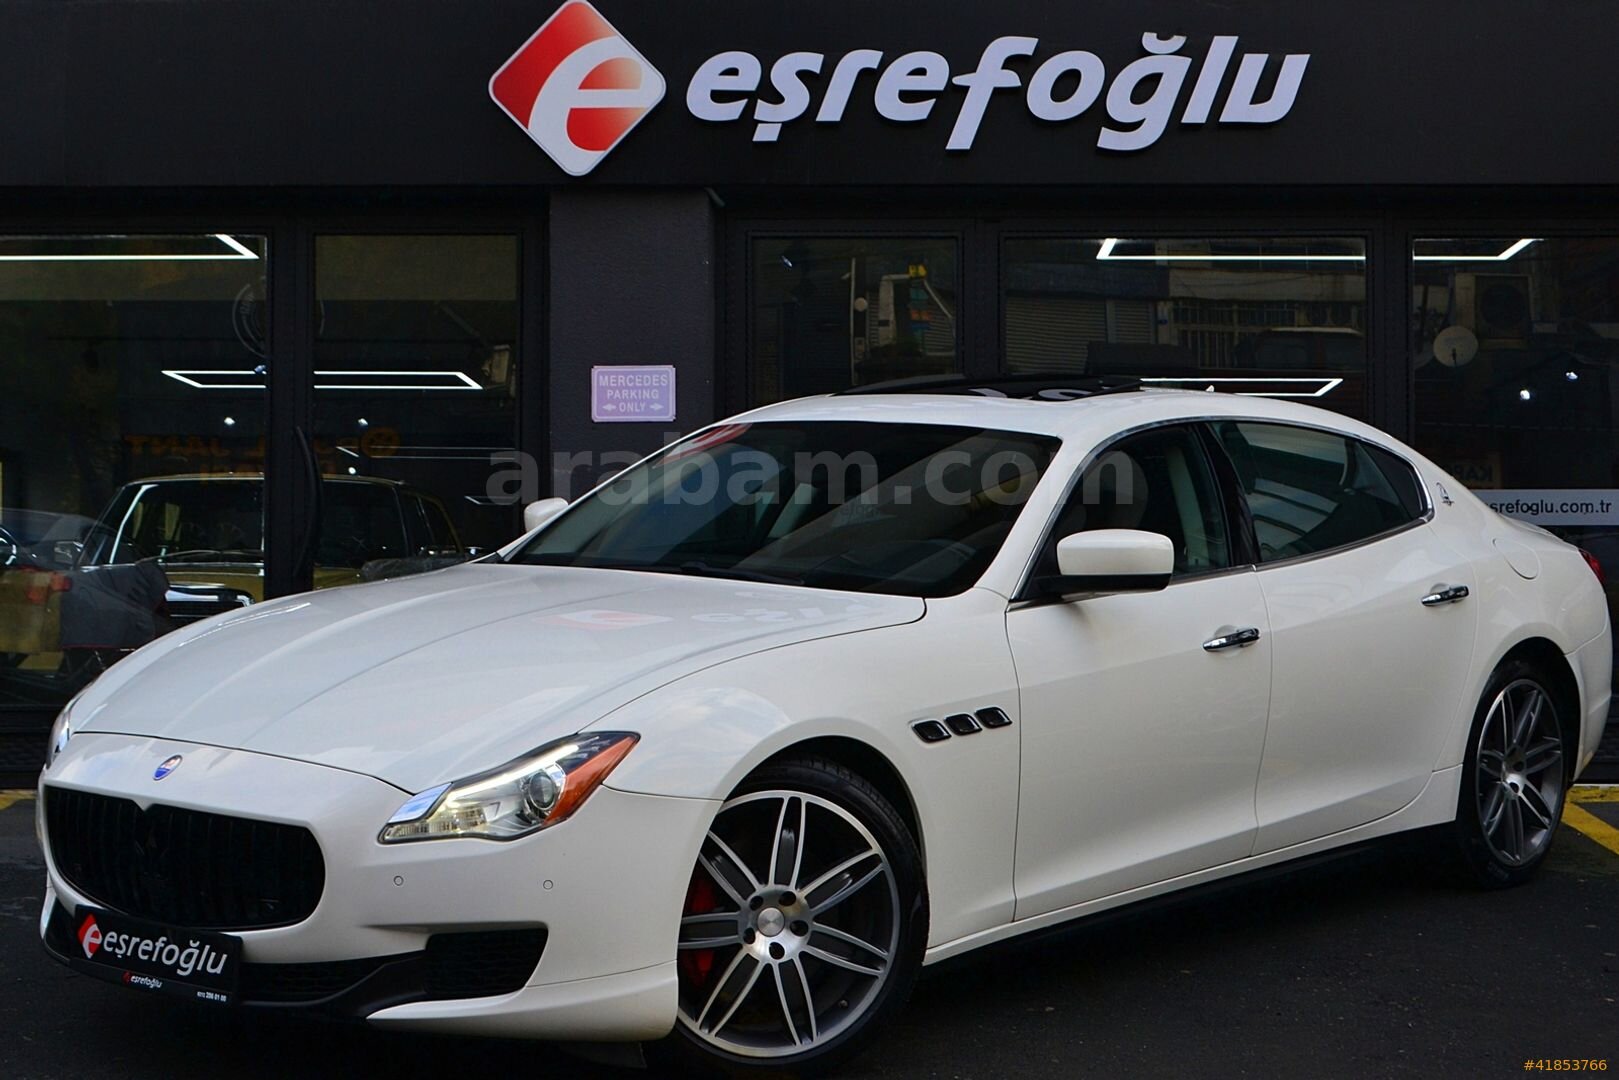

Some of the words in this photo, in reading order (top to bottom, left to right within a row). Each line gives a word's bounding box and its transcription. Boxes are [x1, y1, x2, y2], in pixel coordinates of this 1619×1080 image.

[685, 31, 1311, 152] eşrefoğlu
[599, 374, 668, 387] MERCEDES
[607, 389, 659, 399] PARKING
[619, 402, 646, 412] ONLY
[1486, 499, 1612, 516] srefoglu.com.tr
[103, 931, 228, 977] eşrefoğlu
